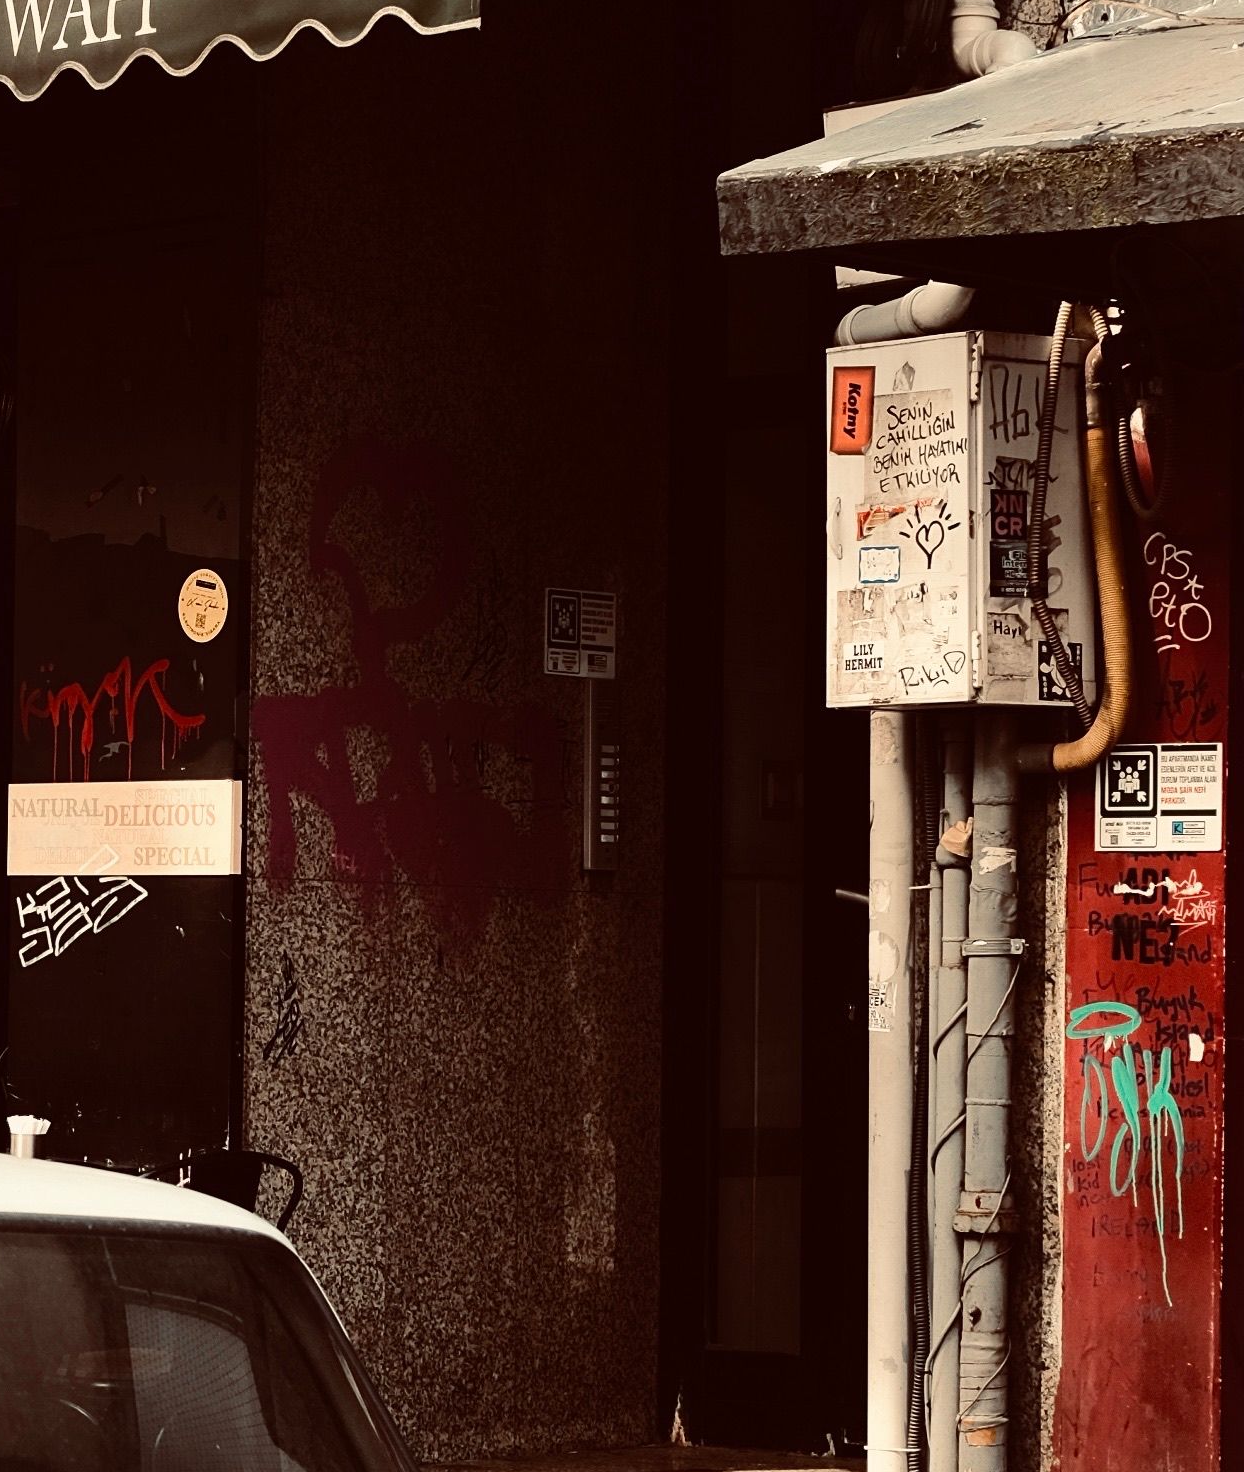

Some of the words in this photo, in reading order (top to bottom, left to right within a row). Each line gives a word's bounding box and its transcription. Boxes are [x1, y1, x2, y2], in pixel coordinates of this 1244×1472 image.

[994, 516, 1023, 536] CR
[853, 643, 875, 657] LILY
[844, 657, 884, 671] HERMIT
[11, 797, 104, 818] NATURAL
[104, 804, 216, 827] DELICIOUS
[133, 846, 216, 866] SPECIAL
